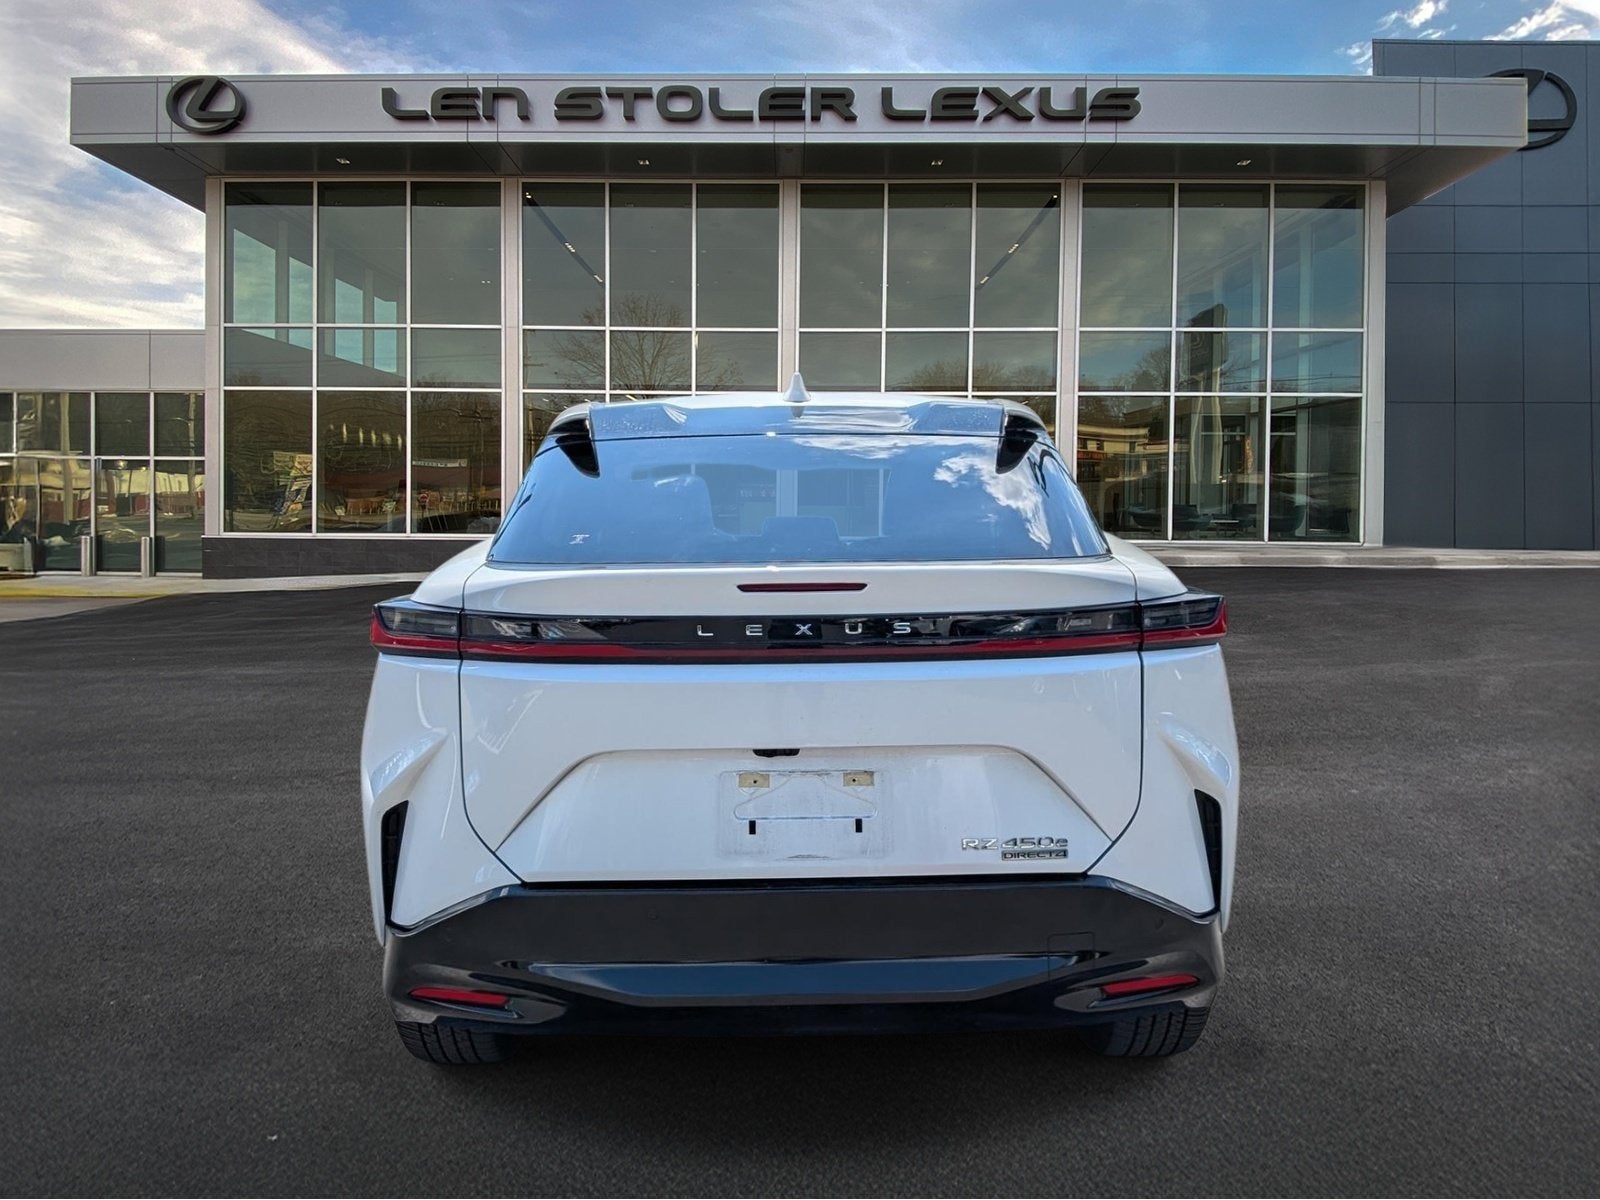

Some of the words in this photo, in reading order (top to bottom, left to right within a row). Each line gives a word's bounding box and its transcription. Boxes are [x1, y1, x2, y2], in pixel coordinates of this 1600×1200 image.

[381, 87, 530, 121] LEN
[554, 85, 858, 121] STOLER
[881, 87, 1142, 121] LEXUS
[696, 622, 912, 636] LEXUS
